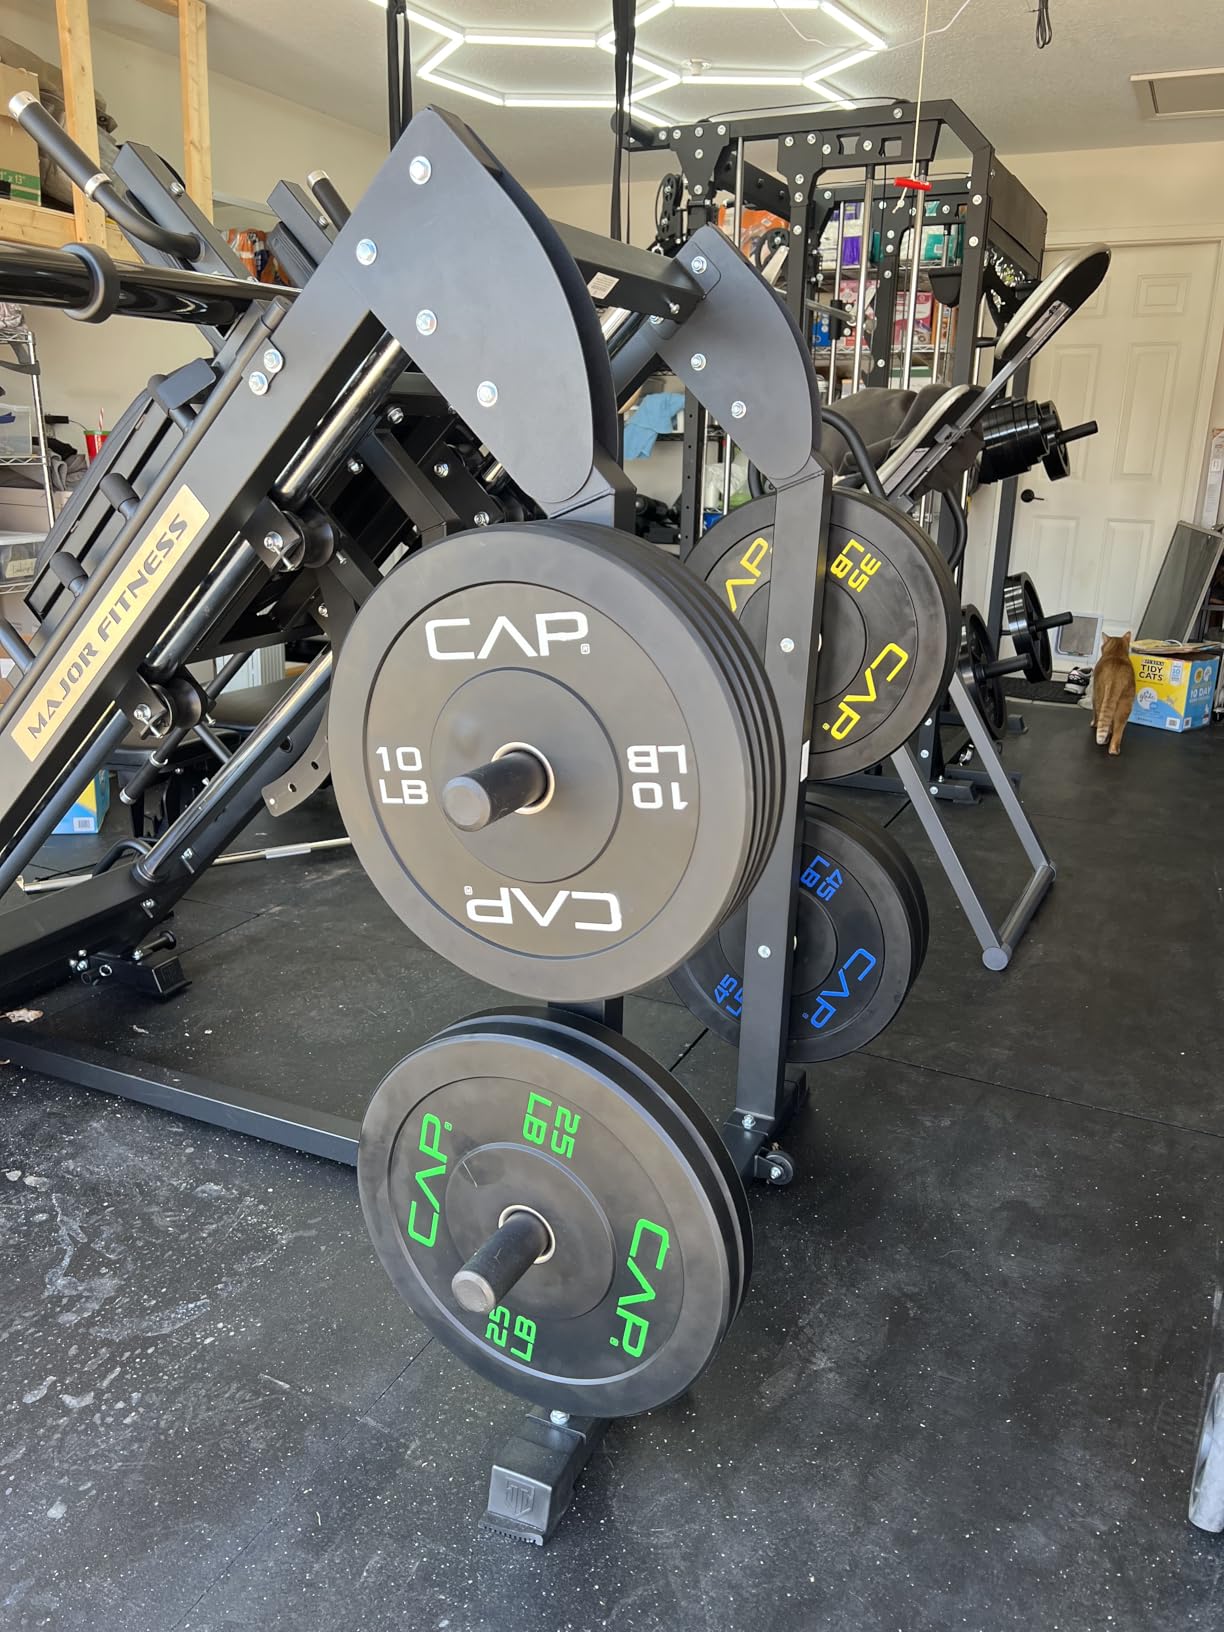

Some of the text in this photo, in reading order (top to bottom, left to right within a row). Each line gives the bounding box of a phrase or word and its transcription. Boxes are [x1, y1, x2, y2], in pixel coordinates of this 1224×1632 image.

[725, 537, 772, 613] AP
[830, 539, 865, 579] LB
[847, 552, 882, 593] 35
[26, 512, 189, 740] MAJOR FITNESS
[424, 611, 590, 661] CAP
[1138, 671, 1164, 682] CATS
[1141, 664, 1163, 674] TIDY
[823, 643, 909, 741] CAP
[375, 746, 423, 772] 10
[626, 744, 688, 774] LB
[378, 779, 429, 805] LB
[631, 781, 689, 810] 10
[800, 855, 831, 888] LB
[816, 868, 844, 902] 45
[463, 886, 623, 932] CAP
[713, 974, 738, 1004] 45
[802, 947, 877, 1029] CAP
[522, 1092, 552, 1145] LB
[550, 1106, 582, 1159] 25
[407, 1112, 453, 1248] CAP
[609, 1218, 671, 1358] CAP
[484, 1305, 511, 1348] 25
[510, 1315, 537, 1362] LB
